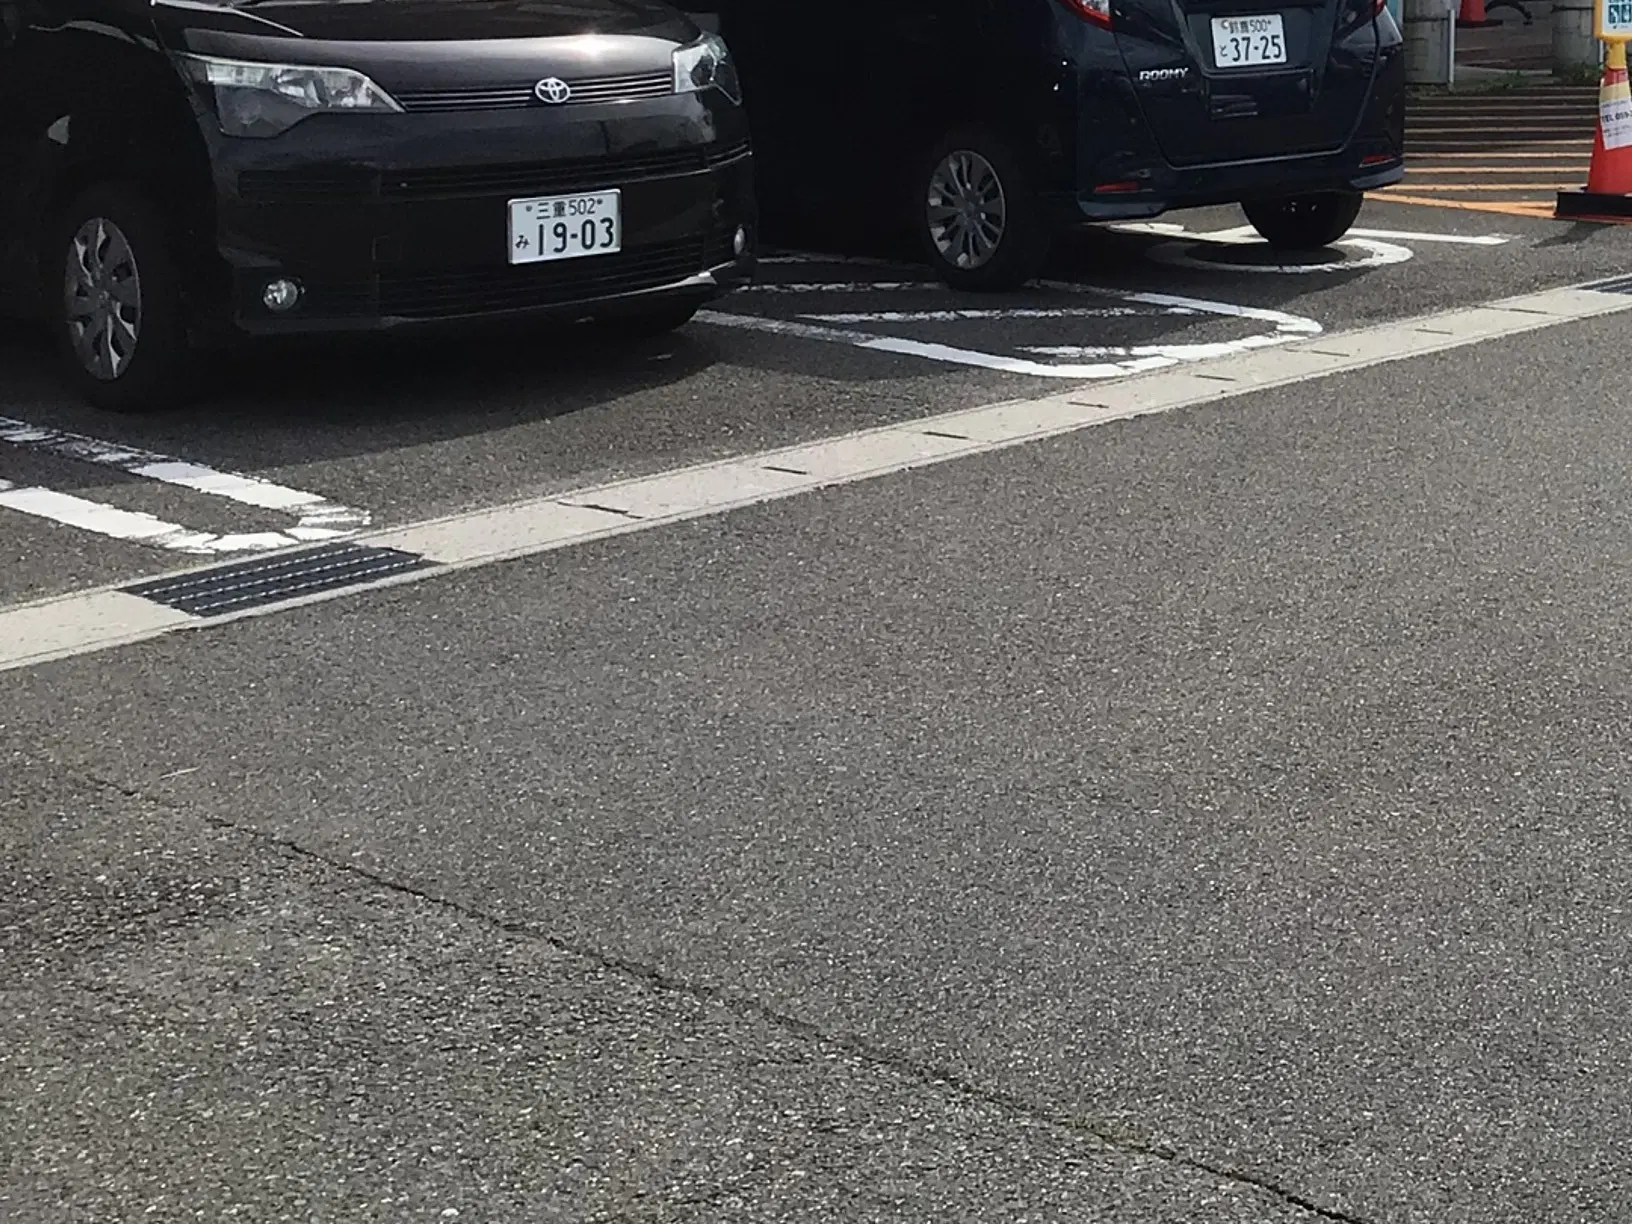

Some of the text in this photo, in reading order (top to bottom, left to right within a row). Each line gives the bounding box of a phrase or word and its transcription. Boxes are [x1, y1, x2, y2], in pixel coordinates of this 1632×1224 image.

[1230, 34, 1282, 63] 37-25
[1139, 67, 1189, 80] ROOMY
[515, 217, 614, 256] み 19-03
